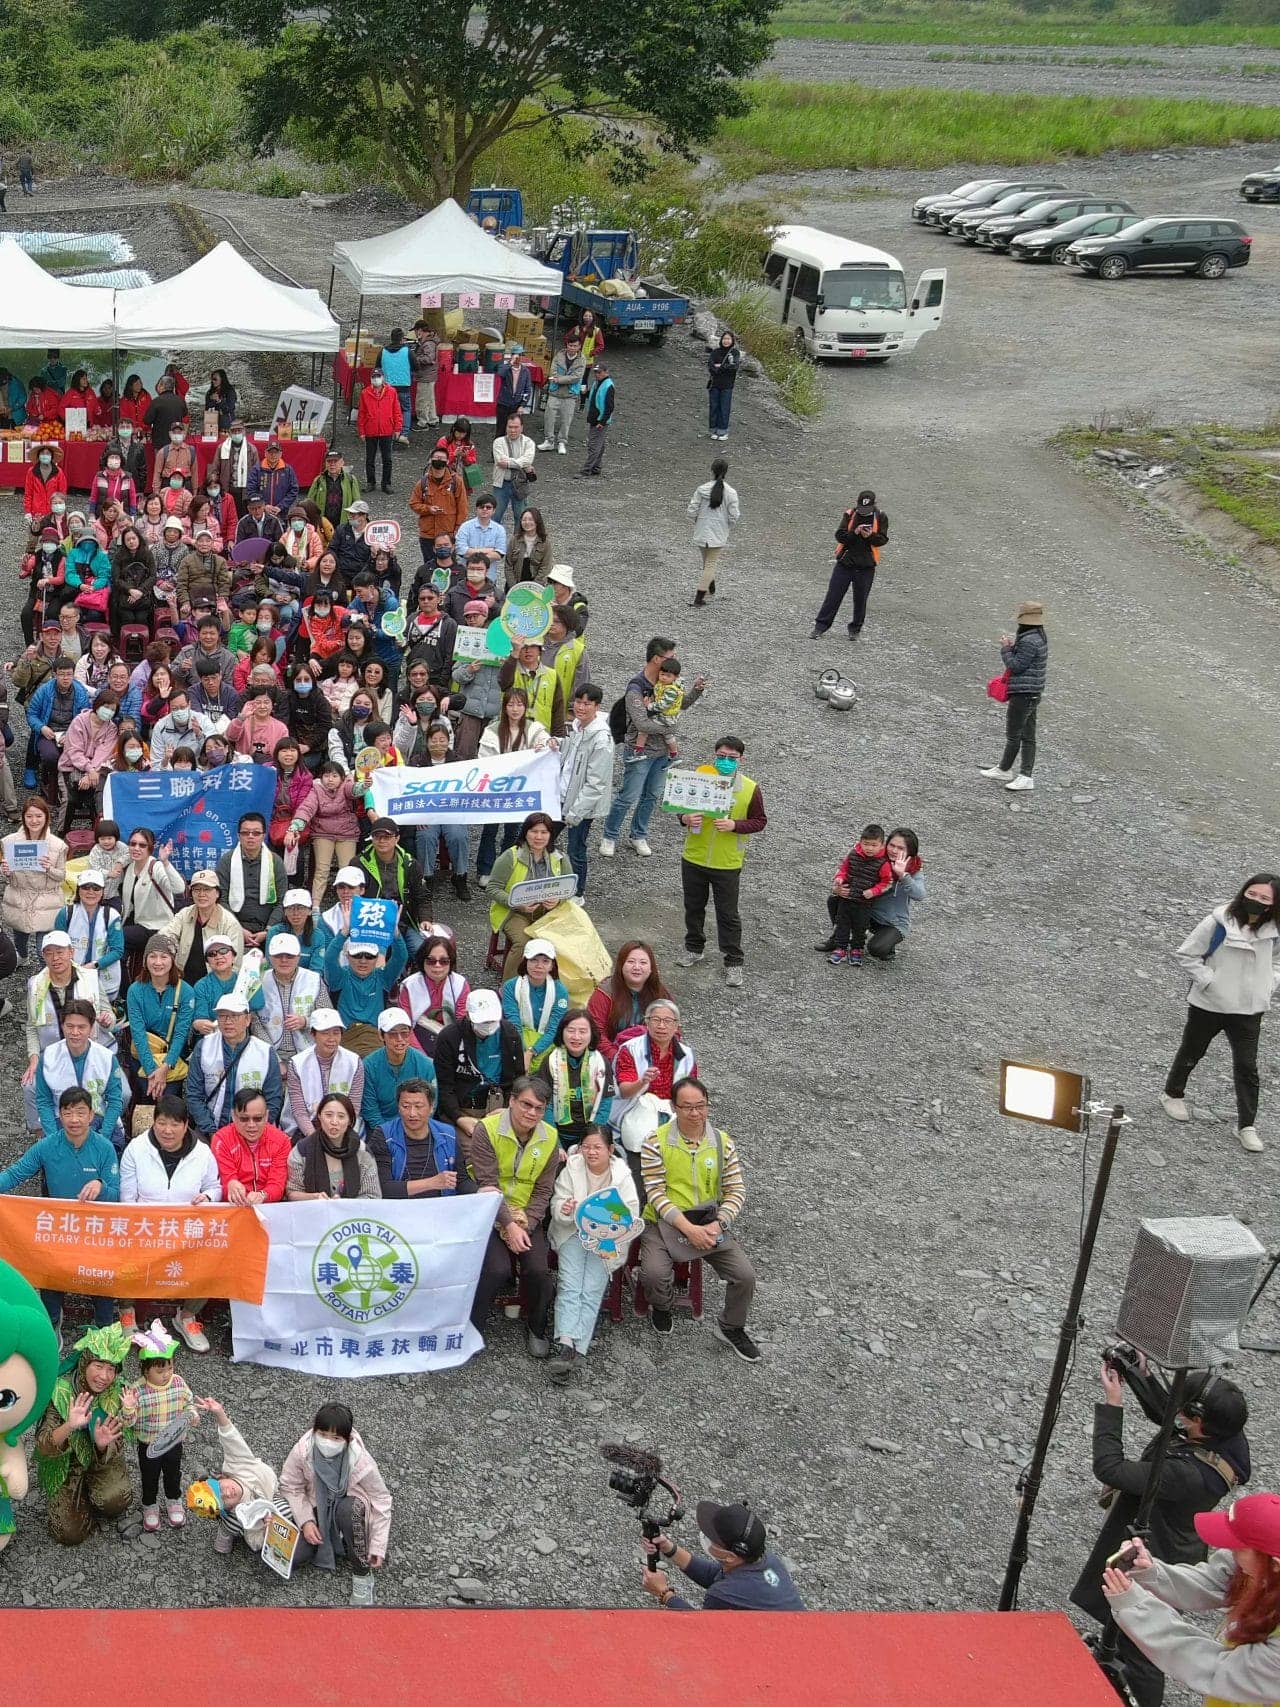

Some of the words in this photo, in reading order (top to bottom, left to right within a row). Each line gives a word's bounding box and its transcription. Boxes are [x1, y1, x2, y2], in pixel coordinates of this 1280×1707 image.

[137, 768, 254, 798] 三聯科技
[403, 767, 527, 796] sanlien
[393, 797, 536, 812] 財團法人三聯科技教育基金會
[357, 901, 386, 928] 強
[35, 1211, 229, 1239] 台北市東大扶輪社
[332, 1222, 372, 1244] DONG
[375, 1225, 397, 1244] TAI
[34, 1232, 81, 1245] ROTARY
[84, 1237, 115, 1247] CLUB
[118, 1238, 133, 1248] OF
[139, 1238, 177, 1249] TAIPEI
[182, 1238, 229, 1250] TUNGDA
[78, 1265, 115, 1279] Rotary
[316, 1262, 341, 1285] 東
[389, 1262, 415, 1284] 泰
[324, 1291, 371, 1321] ROTARY
[373, 1291, 406, 1317] CLUB
